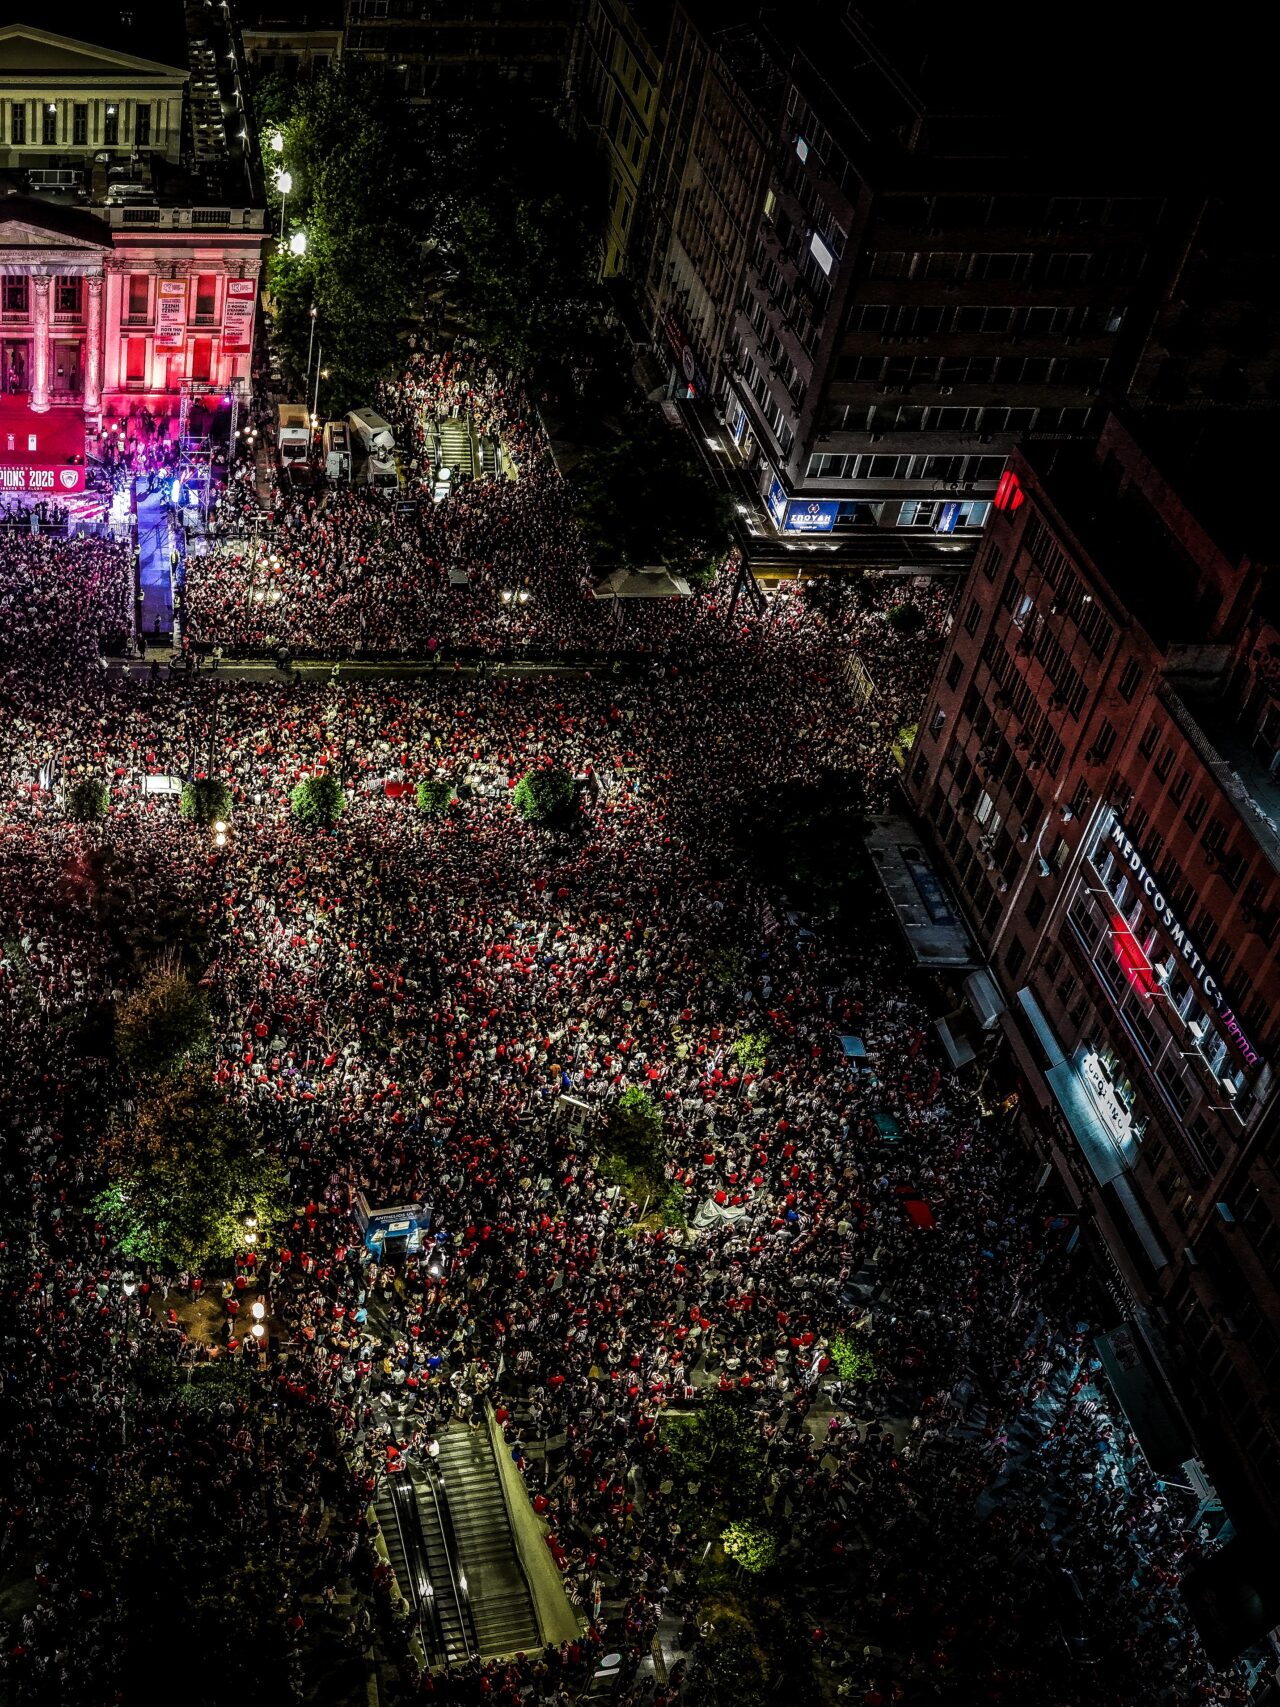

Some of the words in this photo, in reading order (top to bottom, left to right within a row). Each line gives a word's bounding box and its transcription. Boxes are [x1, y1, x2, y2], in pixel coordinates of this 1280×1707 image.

[29, 470, 54, 487] 2026
[790, 514, 832, 522] ΣΠΟΥΔΗ
[1220, 1008, 1258, 1066] Derma
